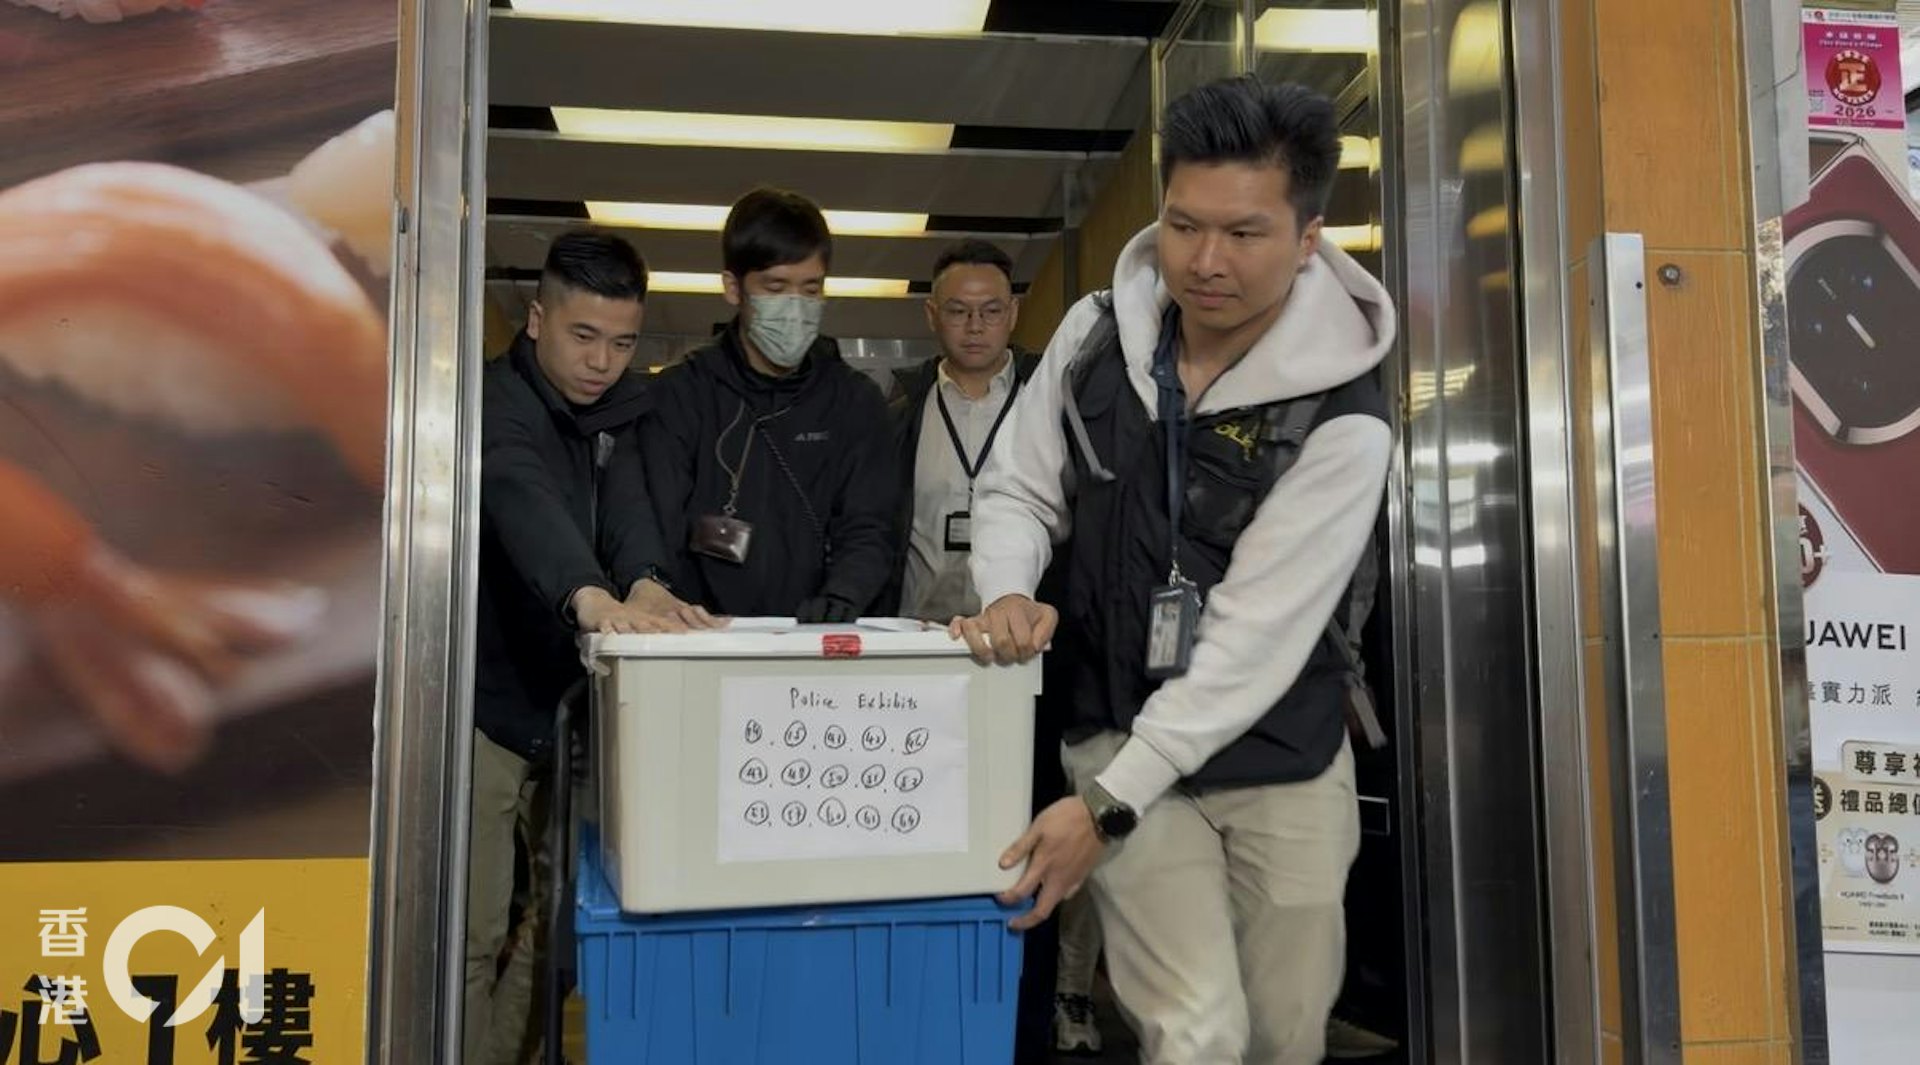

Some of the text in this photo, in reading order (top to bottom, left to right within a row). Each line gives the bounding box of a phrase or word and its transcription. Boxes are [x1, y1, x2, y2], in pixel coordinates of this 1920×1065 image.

[1834, 104, 1876, 118] 2026
[790, 687, 918, 710] Police Exhibits
